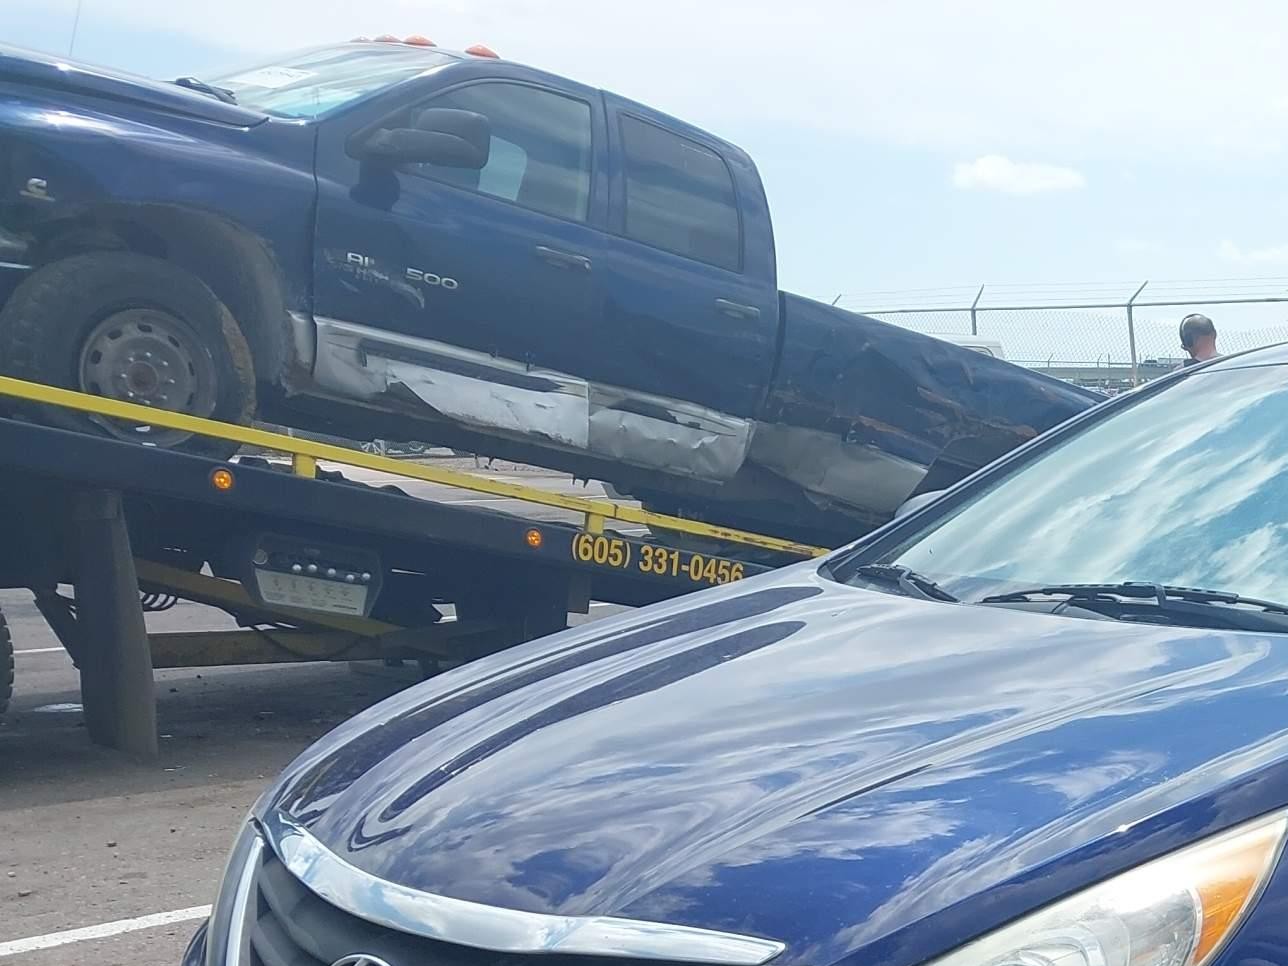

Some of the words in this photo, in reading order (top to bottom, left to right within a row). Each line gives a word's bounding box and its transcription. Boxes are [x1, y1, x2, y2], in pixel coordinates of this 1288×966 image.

[406, 267, 459, 290] 500
[572, 533, 631, 569] (605)
[638, 544, 744, 585] 331-0456
